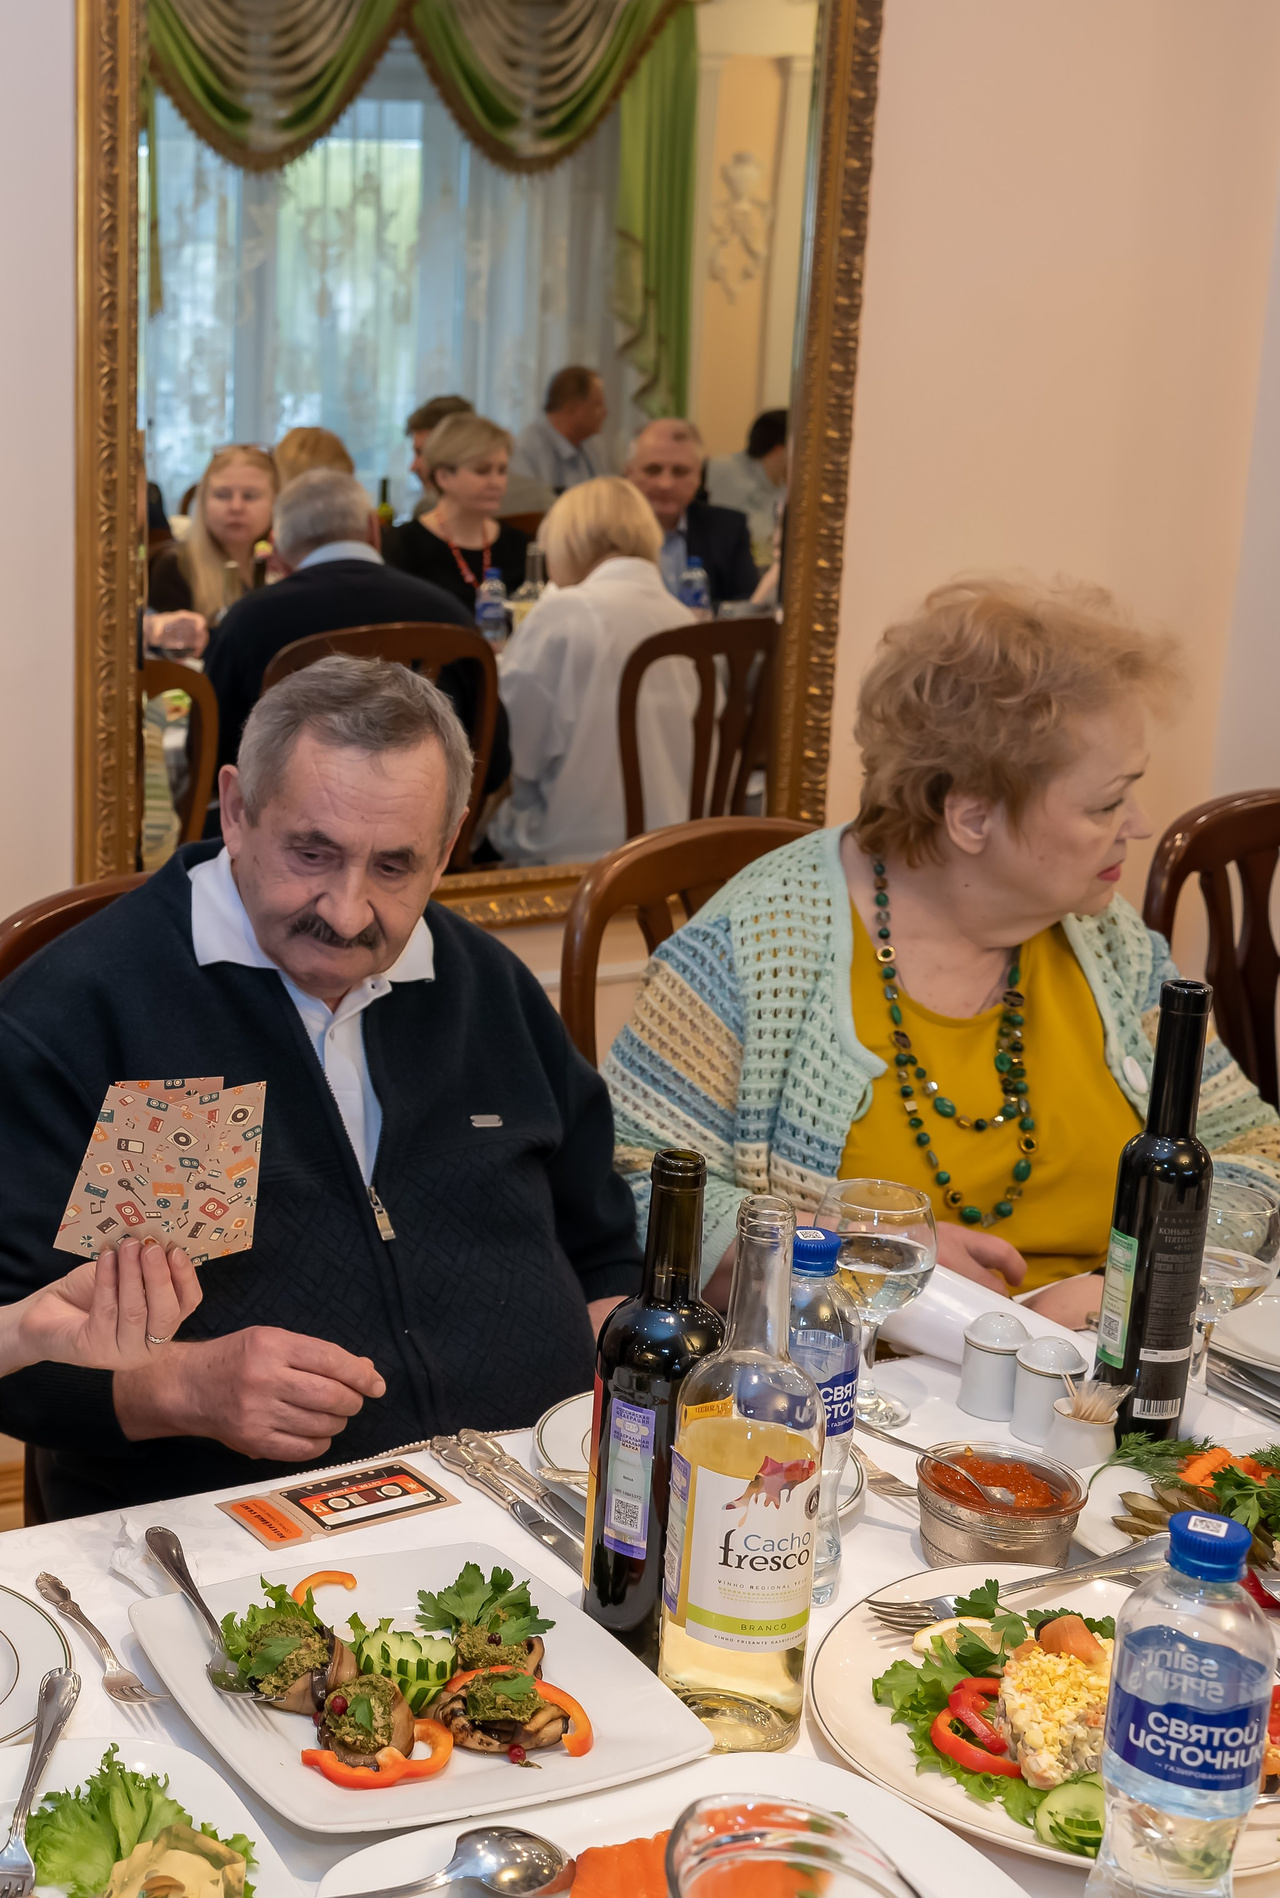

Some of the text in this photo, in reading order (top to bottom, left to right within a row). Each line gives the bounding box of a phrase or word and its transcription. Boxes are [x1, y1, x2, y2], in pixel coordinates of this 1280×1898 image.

[819, 1378, 858, 1403] СВЯТ
[621, 1442, 639, 1452] МАРКА
[718, 1528, 810, 1572] fresco
[743, 1531, 811, 1553] Cacho
[717, 1579, 745, 1589] VINHO
[740, 1623, 787, 1631] BRANCO
[713, 1634, 734, 1643] VINHO
[1147, 1711, 1260, 1748] СВЯТОЙ
